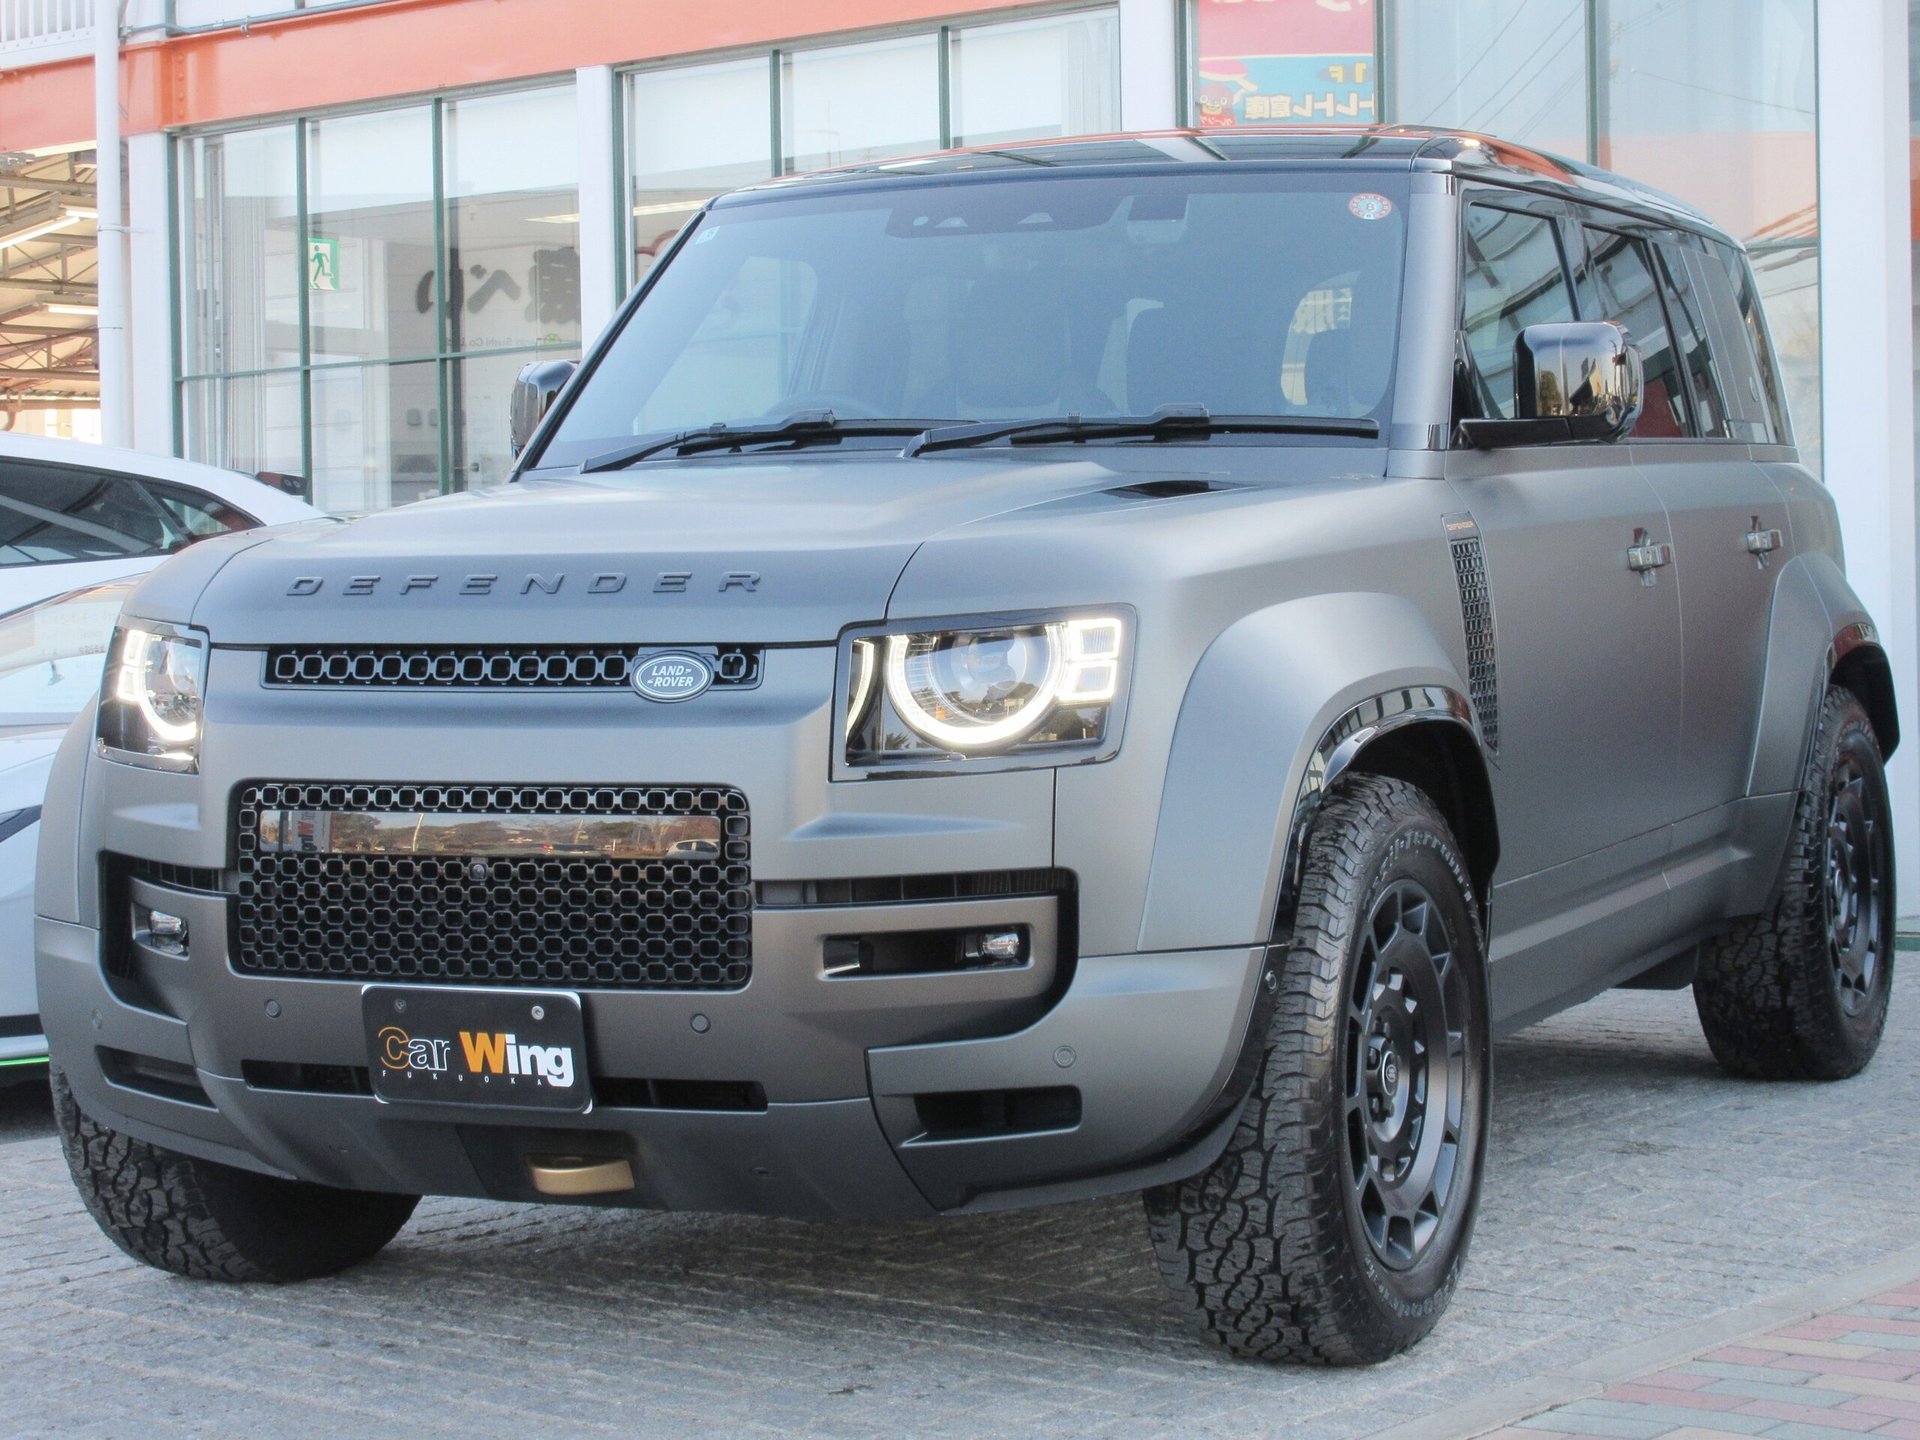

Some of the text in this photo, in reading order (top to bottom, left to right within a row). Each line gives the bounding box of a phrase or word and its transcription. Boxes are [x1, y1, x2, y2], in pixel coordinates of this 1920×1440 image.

[286, 570, 761, 596] DEFENDER
[651, 665, 685, 676] LAND
[653, 676, 694, 687] ROVER
[378, 1026, 574, 1087] Car Wing
[382, 1069, 543, 1086] FUKUOKA
